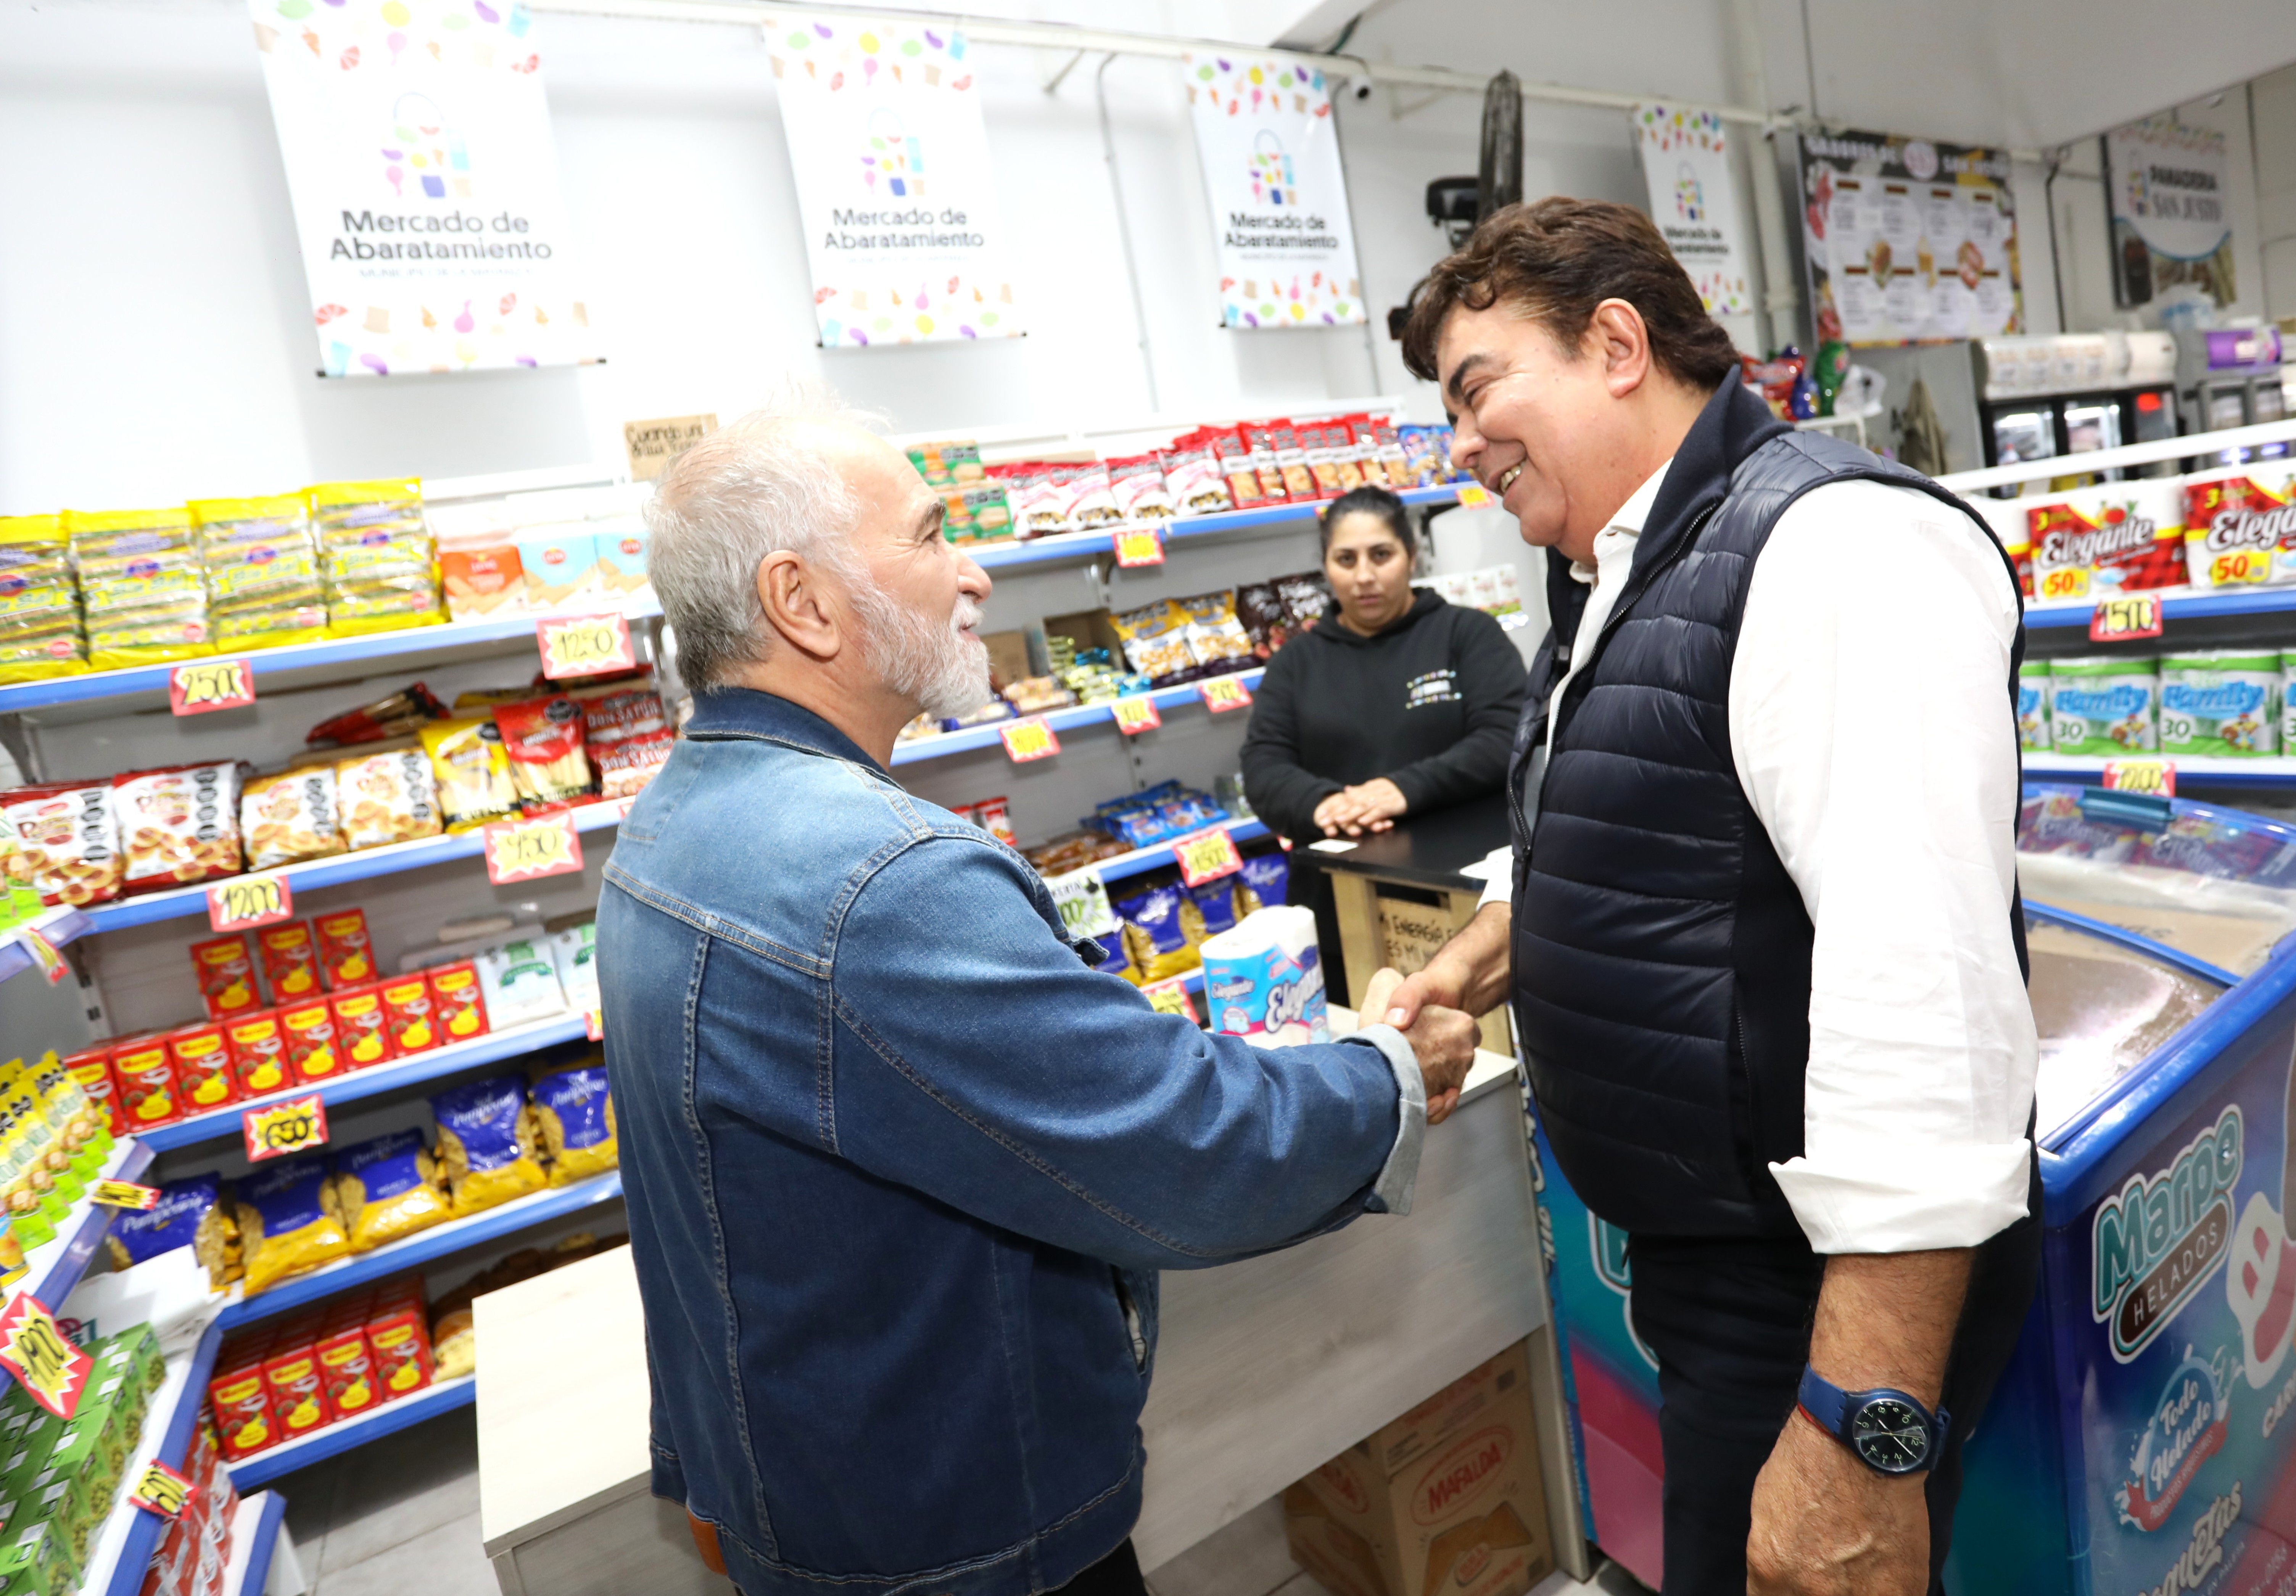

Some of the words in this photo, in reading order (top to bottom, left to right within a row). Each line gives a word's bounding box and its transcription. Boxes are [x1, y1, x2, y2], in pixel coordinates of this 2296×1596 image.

[341, 210, 484, 233] Mercado
[492, 211, 529, 233] de
[832, 207, 934, 225] Mercado
[940, 207, 967, 225] de
[1230, 213, 1302, 228] Mercado
[1307, 214, 1325, 228] de
[330, 237, 552, 260] Abaratamiento
[824, 230, 984, 249] Abaratamiento
[1225, 232, 1338, 247] Abaratamiento
[2204, 488, 2220, 509] 3
[2041, 517, 2154, 569] Elegante
[2217, 555, 2248, 580] 50
[2049, 573, 2074, 595] 50
[560, 629, 613, 659] 1250
[181, 668, 243, 706] 2500
[2164, 682, 2263, 713] Family
[2056, 684, 2148, 714] Family
[587, 713, 615, 728] DON
[2058, 721, 2082, 738] 30
[2162, 719, 2190, 737] 30
[599, 755, 630, 771] DON
[222, 882, 281, 920] 1200
[266, 1117, 312, 1148] 650
[2098, 1112, 2240, 1311] Marpe
[2133, 1221, 2218, 1327] HELADOS
[1902, 1413, 1912, 1424] 10
[2159, 1379, 2198, 1435] Todo
[1870, 1444, 1877, 1452] 4
[1911, 1437, 1920, 1446] 12
[2151, 1400, 2210, 1491] Helado
[1428, 1442, 1502, 1514] MAFALDA
